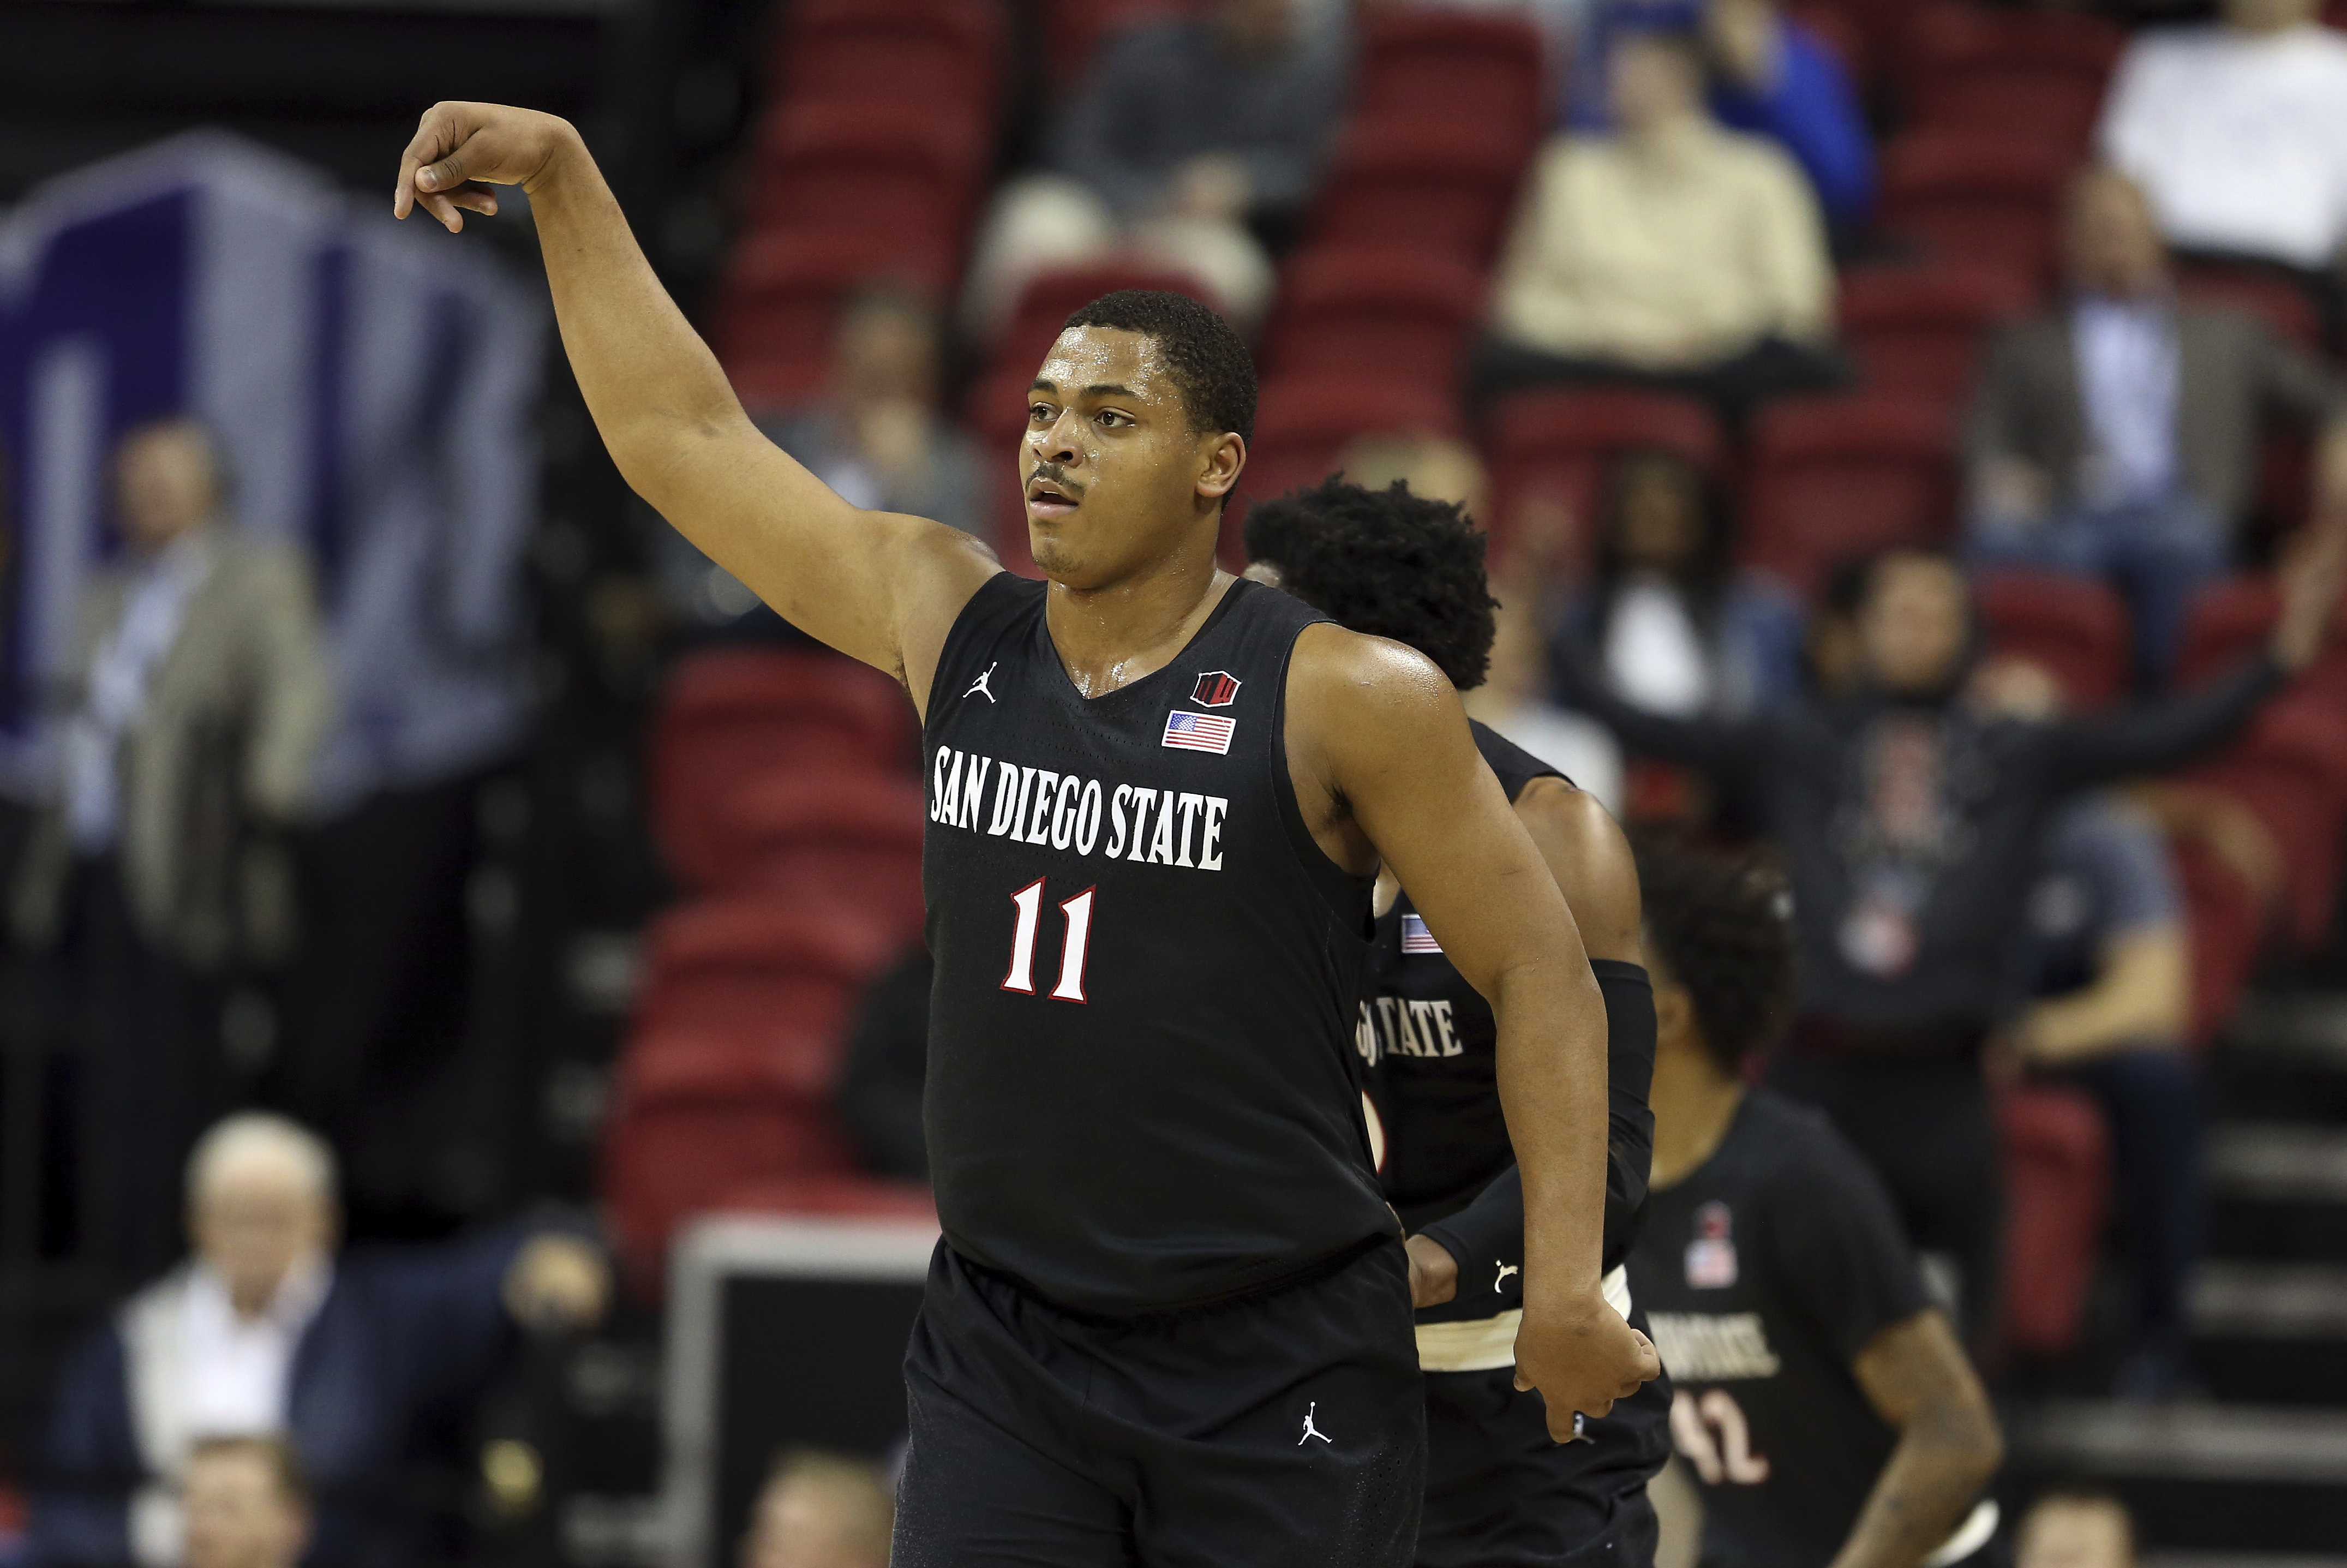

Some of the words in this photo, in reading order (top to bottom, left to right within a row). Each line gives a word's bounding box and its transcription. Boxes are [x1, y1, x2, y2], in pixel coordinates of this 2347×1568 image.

[930, 745, 992, 833] SAN
[987, 759, 1103, 857] DIEGO
[1105, 783, 1229, 871] STATE
[999, 876, 1097, 1005] 11
[1374, 996, 1464, 1058] TATE
